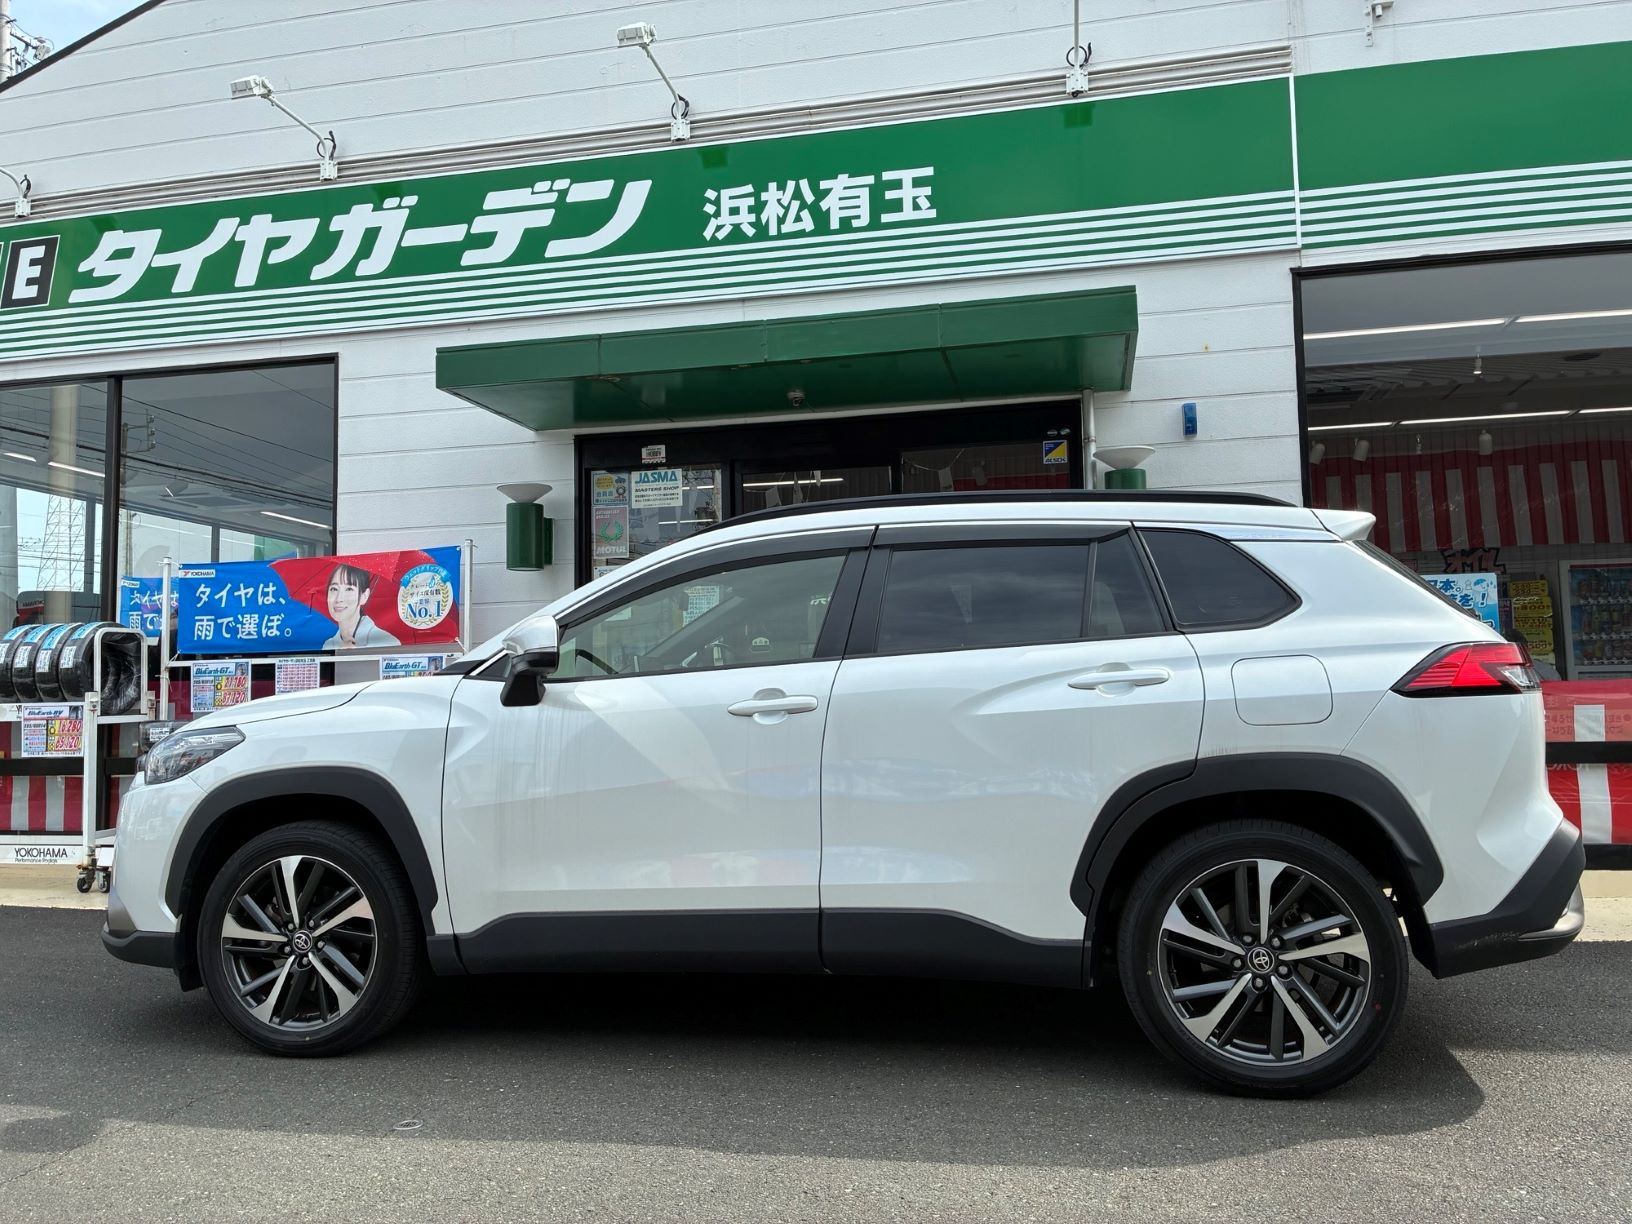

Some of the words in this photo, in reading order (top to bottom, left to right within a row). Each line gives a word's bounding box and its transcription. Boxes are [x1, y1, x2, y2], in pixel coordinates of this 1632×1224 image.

[703, 166, 937, 241] 浜松有玉
[68, 178, 652, 304] タイヤガーデン
[635, 471, 678, 484] JASMA
[597, 545, 626, 554] MOTUL
[195, 582, 286, 608] タイヤは、
[404, 600, 442, 619] No.1
[194, 613, 292, 640] 雨で選ぼ。
[14, 848, 68, 858] YOKOHAMA
